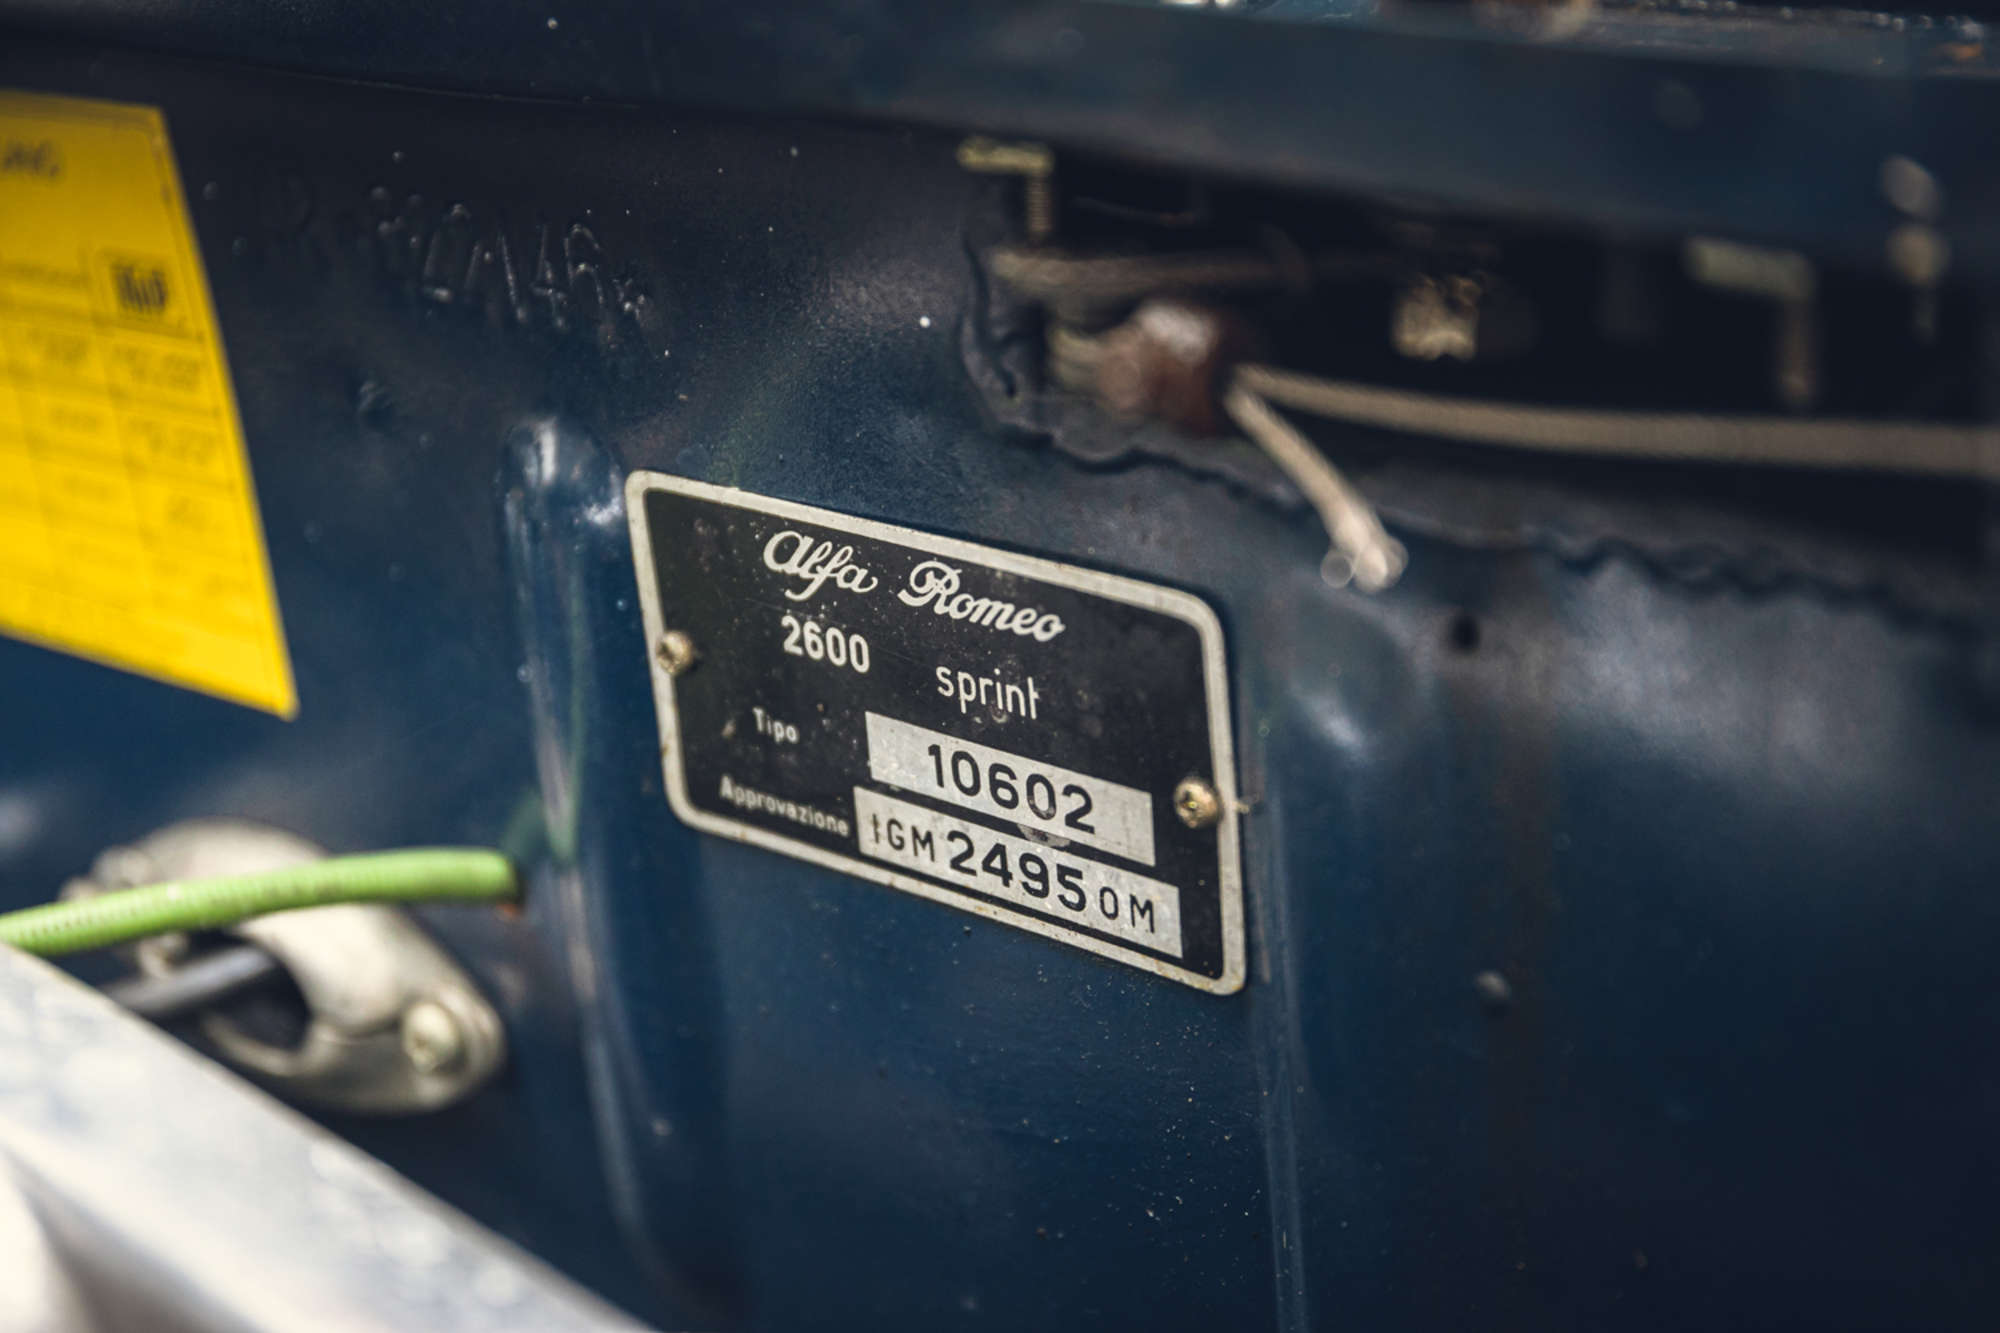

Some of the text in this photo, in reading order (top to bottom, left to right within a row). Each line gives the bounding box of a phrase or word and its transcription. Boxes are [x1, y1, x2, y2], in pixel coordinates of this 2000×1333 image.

[763, 531, 1066, 642] Alfa Romeo
[781, 615, 870, 673] 2600
[935, 666, 1040, 719] sprint
[752, 707, 799, 743] Tipo
[720, 774, 849, 837] Approvazione
[927, 744, 1095, 835] 10602
